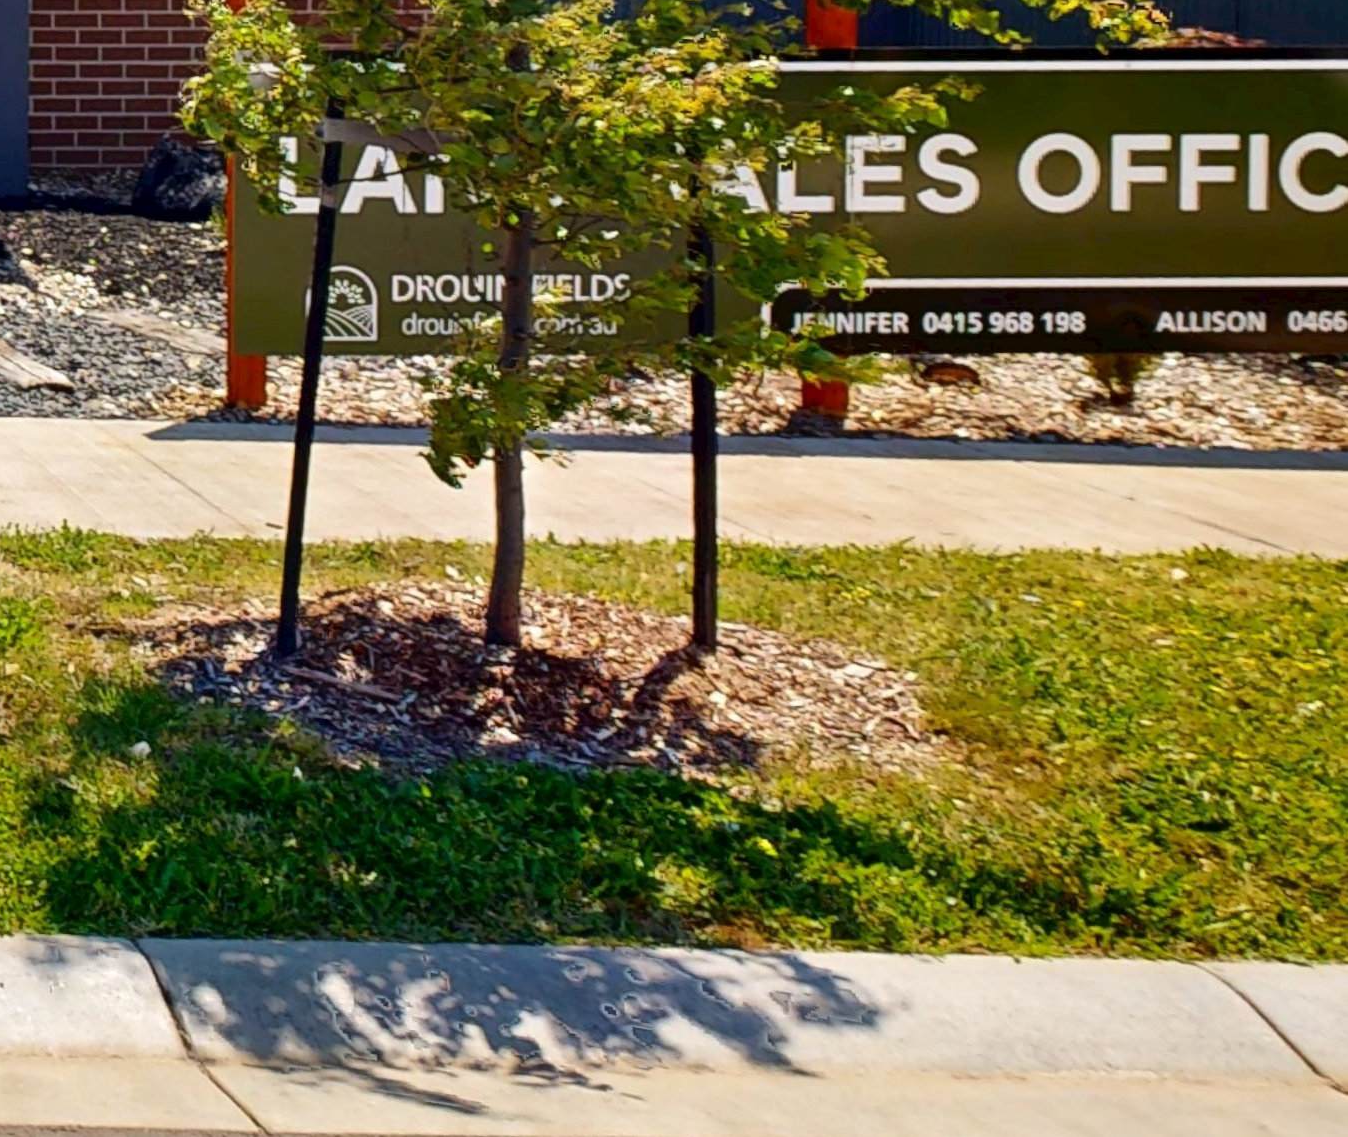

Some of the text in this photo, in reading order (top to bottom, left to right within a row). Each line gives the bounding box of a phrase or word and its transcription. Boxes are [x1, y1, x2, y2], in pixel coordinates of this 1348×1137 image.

[709, 132, 981, 214] ALES
[531, 273, 632, 302] FIELDS
[791, 310, 1348, 334] JENNIFER 0415 968 198 ALLISON 0466
